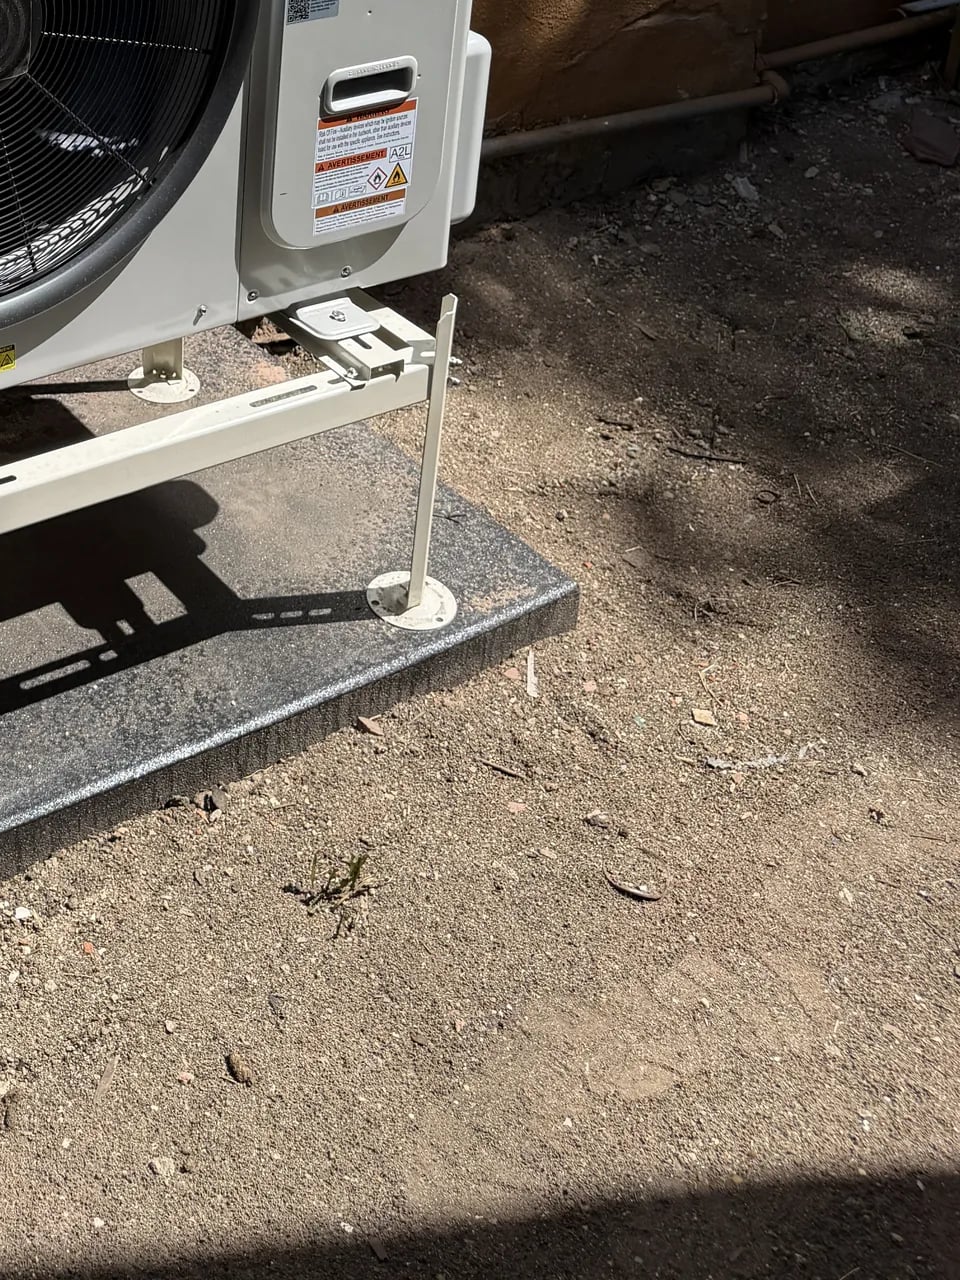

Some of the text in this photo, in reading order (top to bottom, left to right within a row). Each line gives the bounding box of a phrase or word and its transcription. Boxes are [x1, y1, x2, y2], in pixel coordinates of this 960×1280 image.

[328, 150, 384, 169] AVERTISSEMENT
[390, 146, 410, 158] A2L
[341, 194, 389, 210] AVERTISSEMENT
